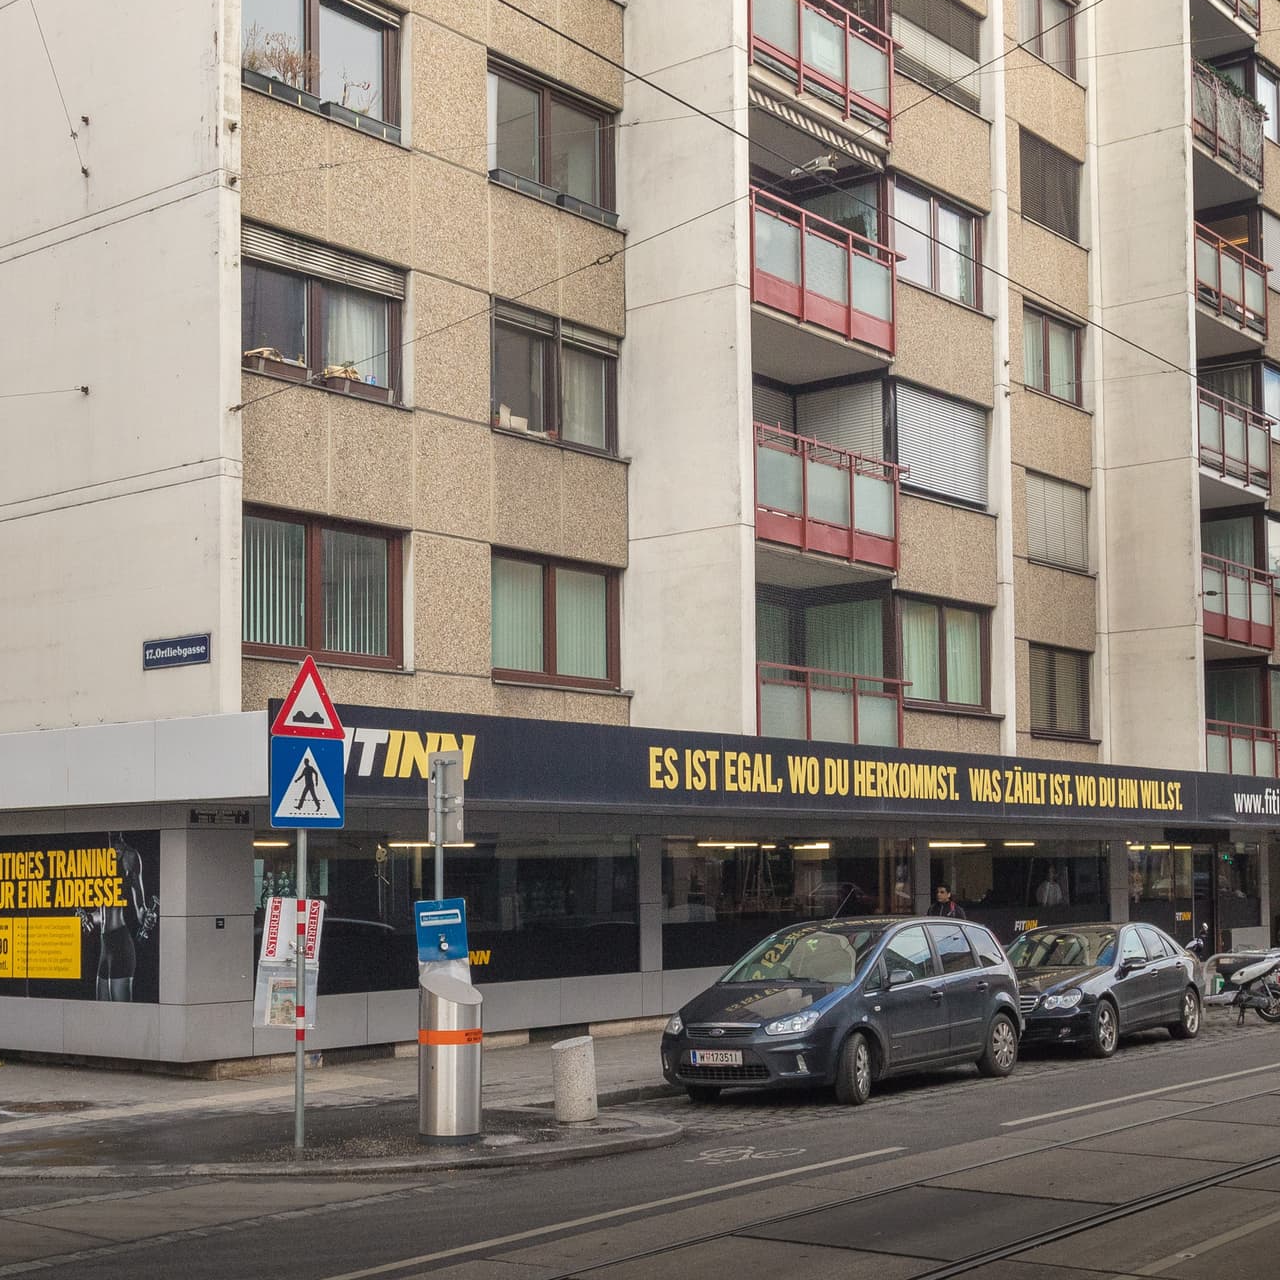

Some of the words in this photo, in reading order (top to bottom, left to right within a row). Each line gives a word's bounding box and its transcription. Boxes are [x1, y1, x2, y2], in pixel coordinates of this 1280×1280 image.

[649, 746, 679, 790] ES
[685, 749, 720, 791] IST
[724, 751, 783, 793] EGAL,
[787, 755, 820, 796] WO
[824, 758, 849, 796] DU
[854, 760, 960, 801] HERKOMMST.
[969, 768, 1002, 803] WAS
[1004, 766, 1047, 804] ZÄHLT
[1050, 773, 1073, 806] IST,
[1075, 775, 1097, 807] WO
[1100, 776, 1115, 808] DU
[1118, 778, 1138, 809] HIN
[1140, 780, 1183, 811] WILLST.
[47, 848, 117, 879] TRAINING
[18, 880, 51, 908] EINE
[55, 877, 128, 908] ADRESSE.
[266, 898, 282, 957] ÖSTERREICH
